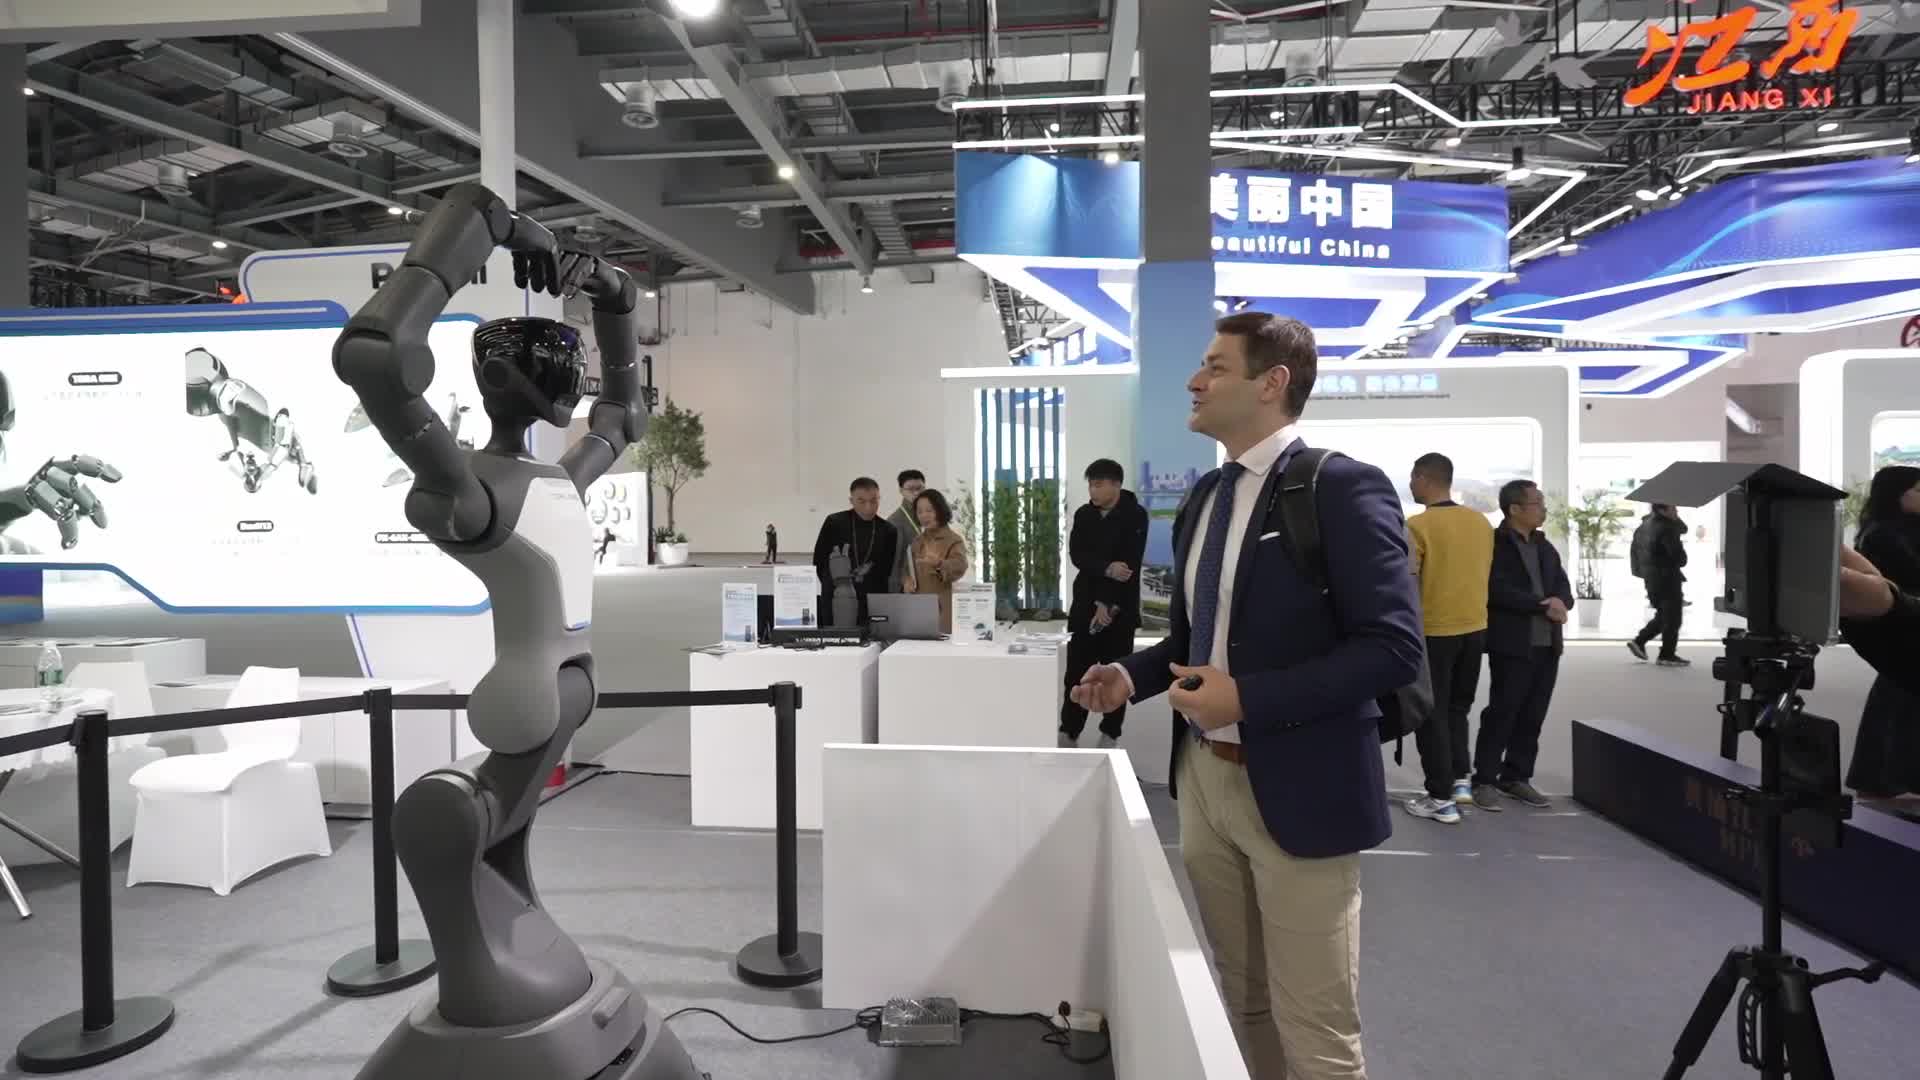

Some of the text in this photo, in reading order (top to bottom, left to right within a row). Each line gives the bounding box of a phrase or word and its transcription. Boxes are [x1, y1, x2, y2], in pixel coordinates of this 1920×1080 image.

[1623, 0, 1858, 107] 江西
[1687, 86, 1834, 114] JIANG XI
[1210, 173, 1393, 229] 美丽中国
[1210, 234, 1391, 259] eautiful China
